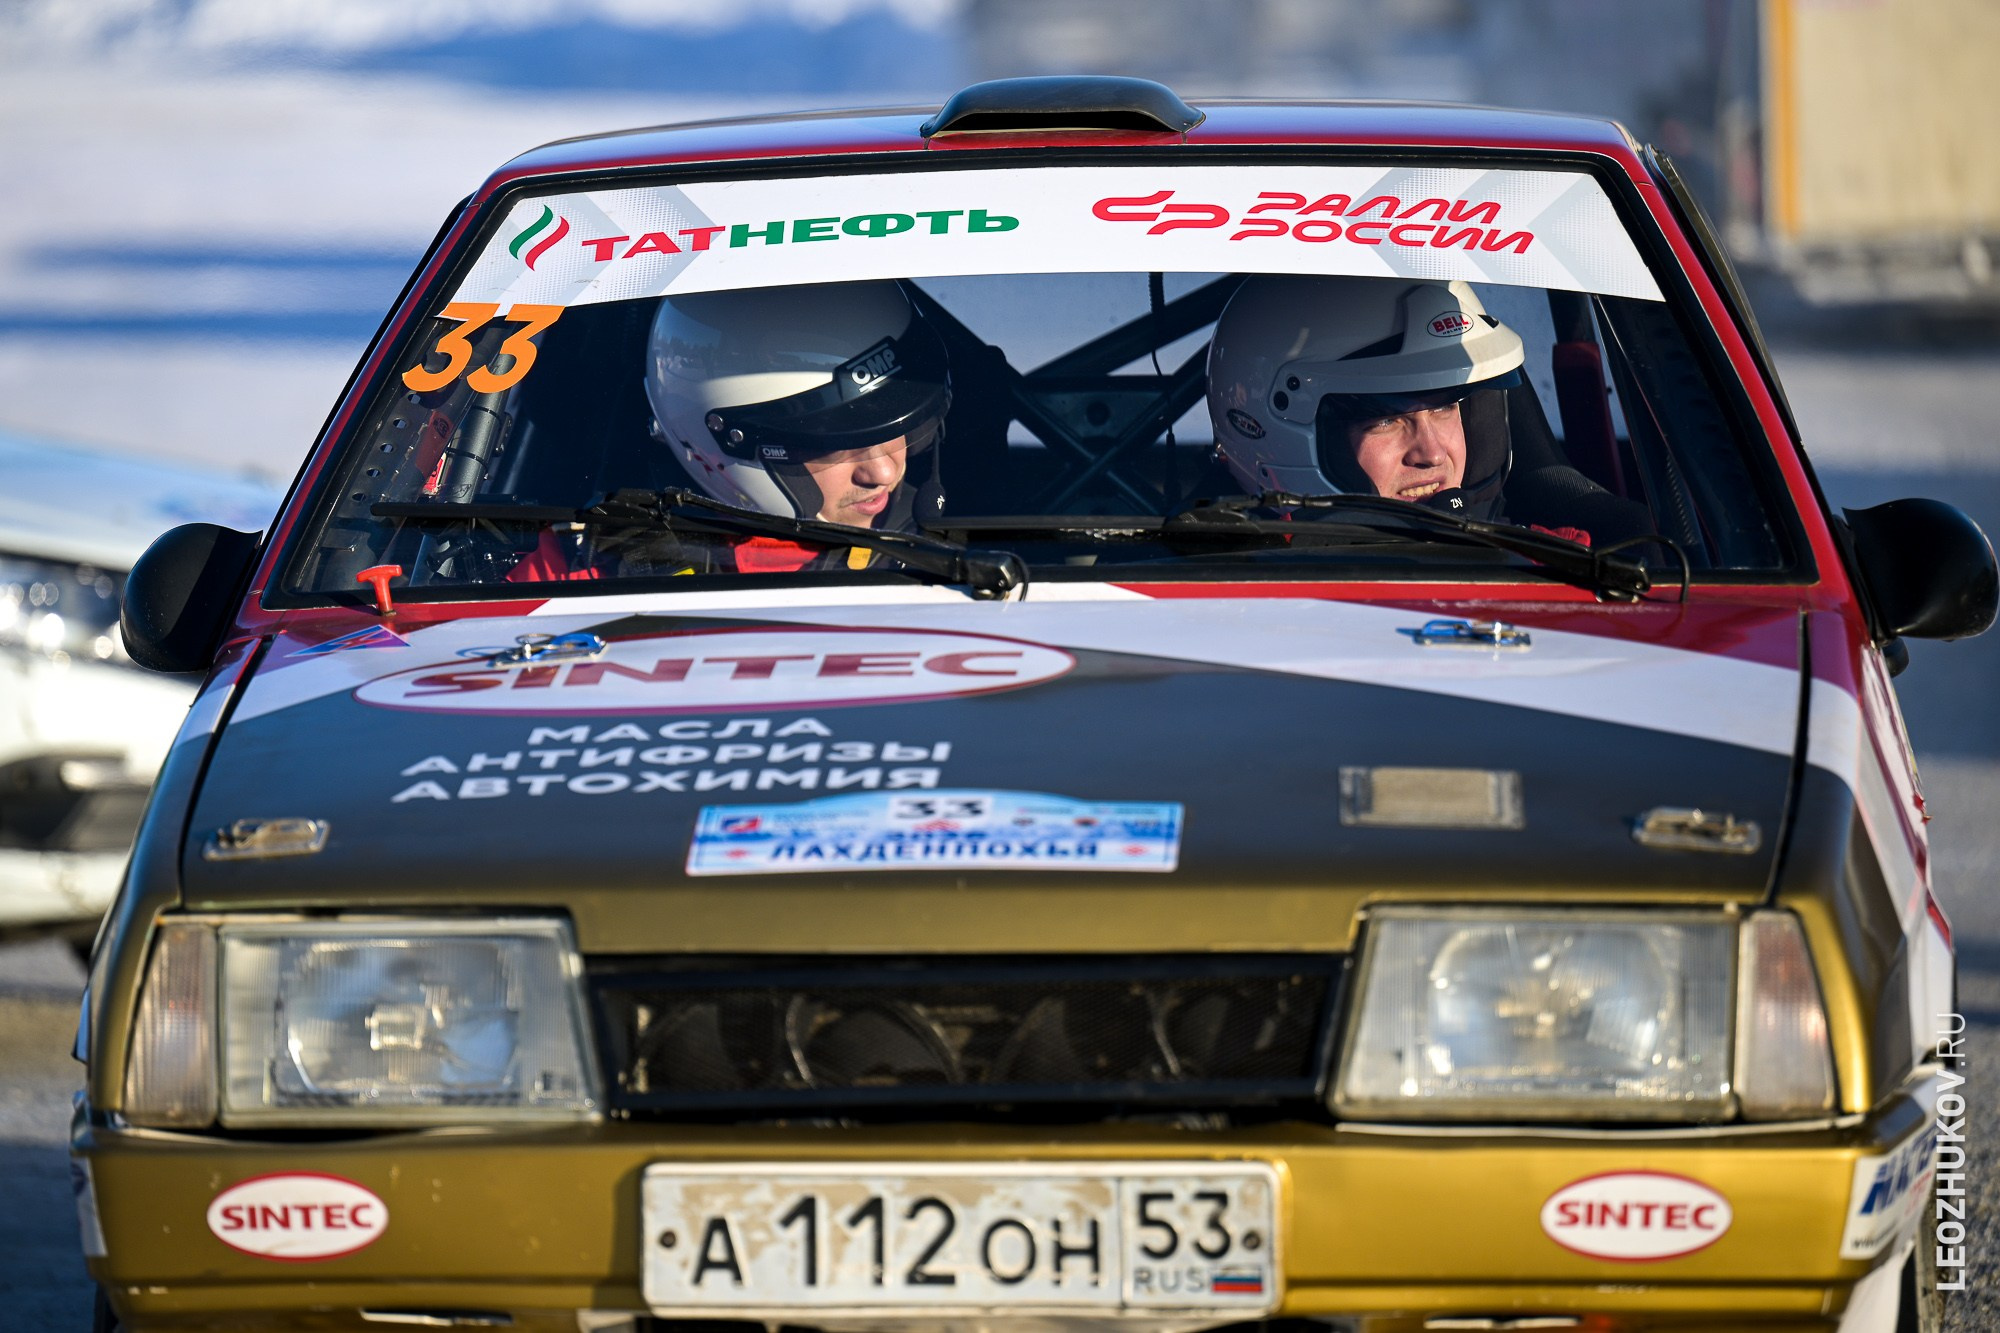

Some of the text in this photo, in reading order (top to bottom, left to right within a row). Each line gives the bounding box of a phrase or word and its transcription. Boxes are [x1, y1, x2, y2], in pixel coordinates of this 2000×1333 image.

[1247, 191, 1502, 224] РАЛЛИ
[581, 208, 1020, 263] ТАТНЕФТЬ
[1229, 218, 1535, 255] РОССИИ
[1432, 314, 1470, 333] BELL
[402, 302, 566, 393] 33
[851, 348, 896, 385] OMP
[763, 447, 786, 458] OMP
[403, 651, 1024, 699] SINTEC
[527, 717, 833, 746] МАСЛА
[401, 741, 953, 777] АНТИФРИЗЫ
[391, 767, 942, 803] АВТОХИМИЯ
[896, 799, 983, 818] 33
[770, 841, 1097, 862] ЛАХДЕНПОХЬЯ
[221, 1202, 375, 1231] SINTEC
[1137, 1190, 1232, 1261] 53
[1556, 1201, 1718, 1231] SINTEC
[1133, 1268, 1205, 1294] RUS
